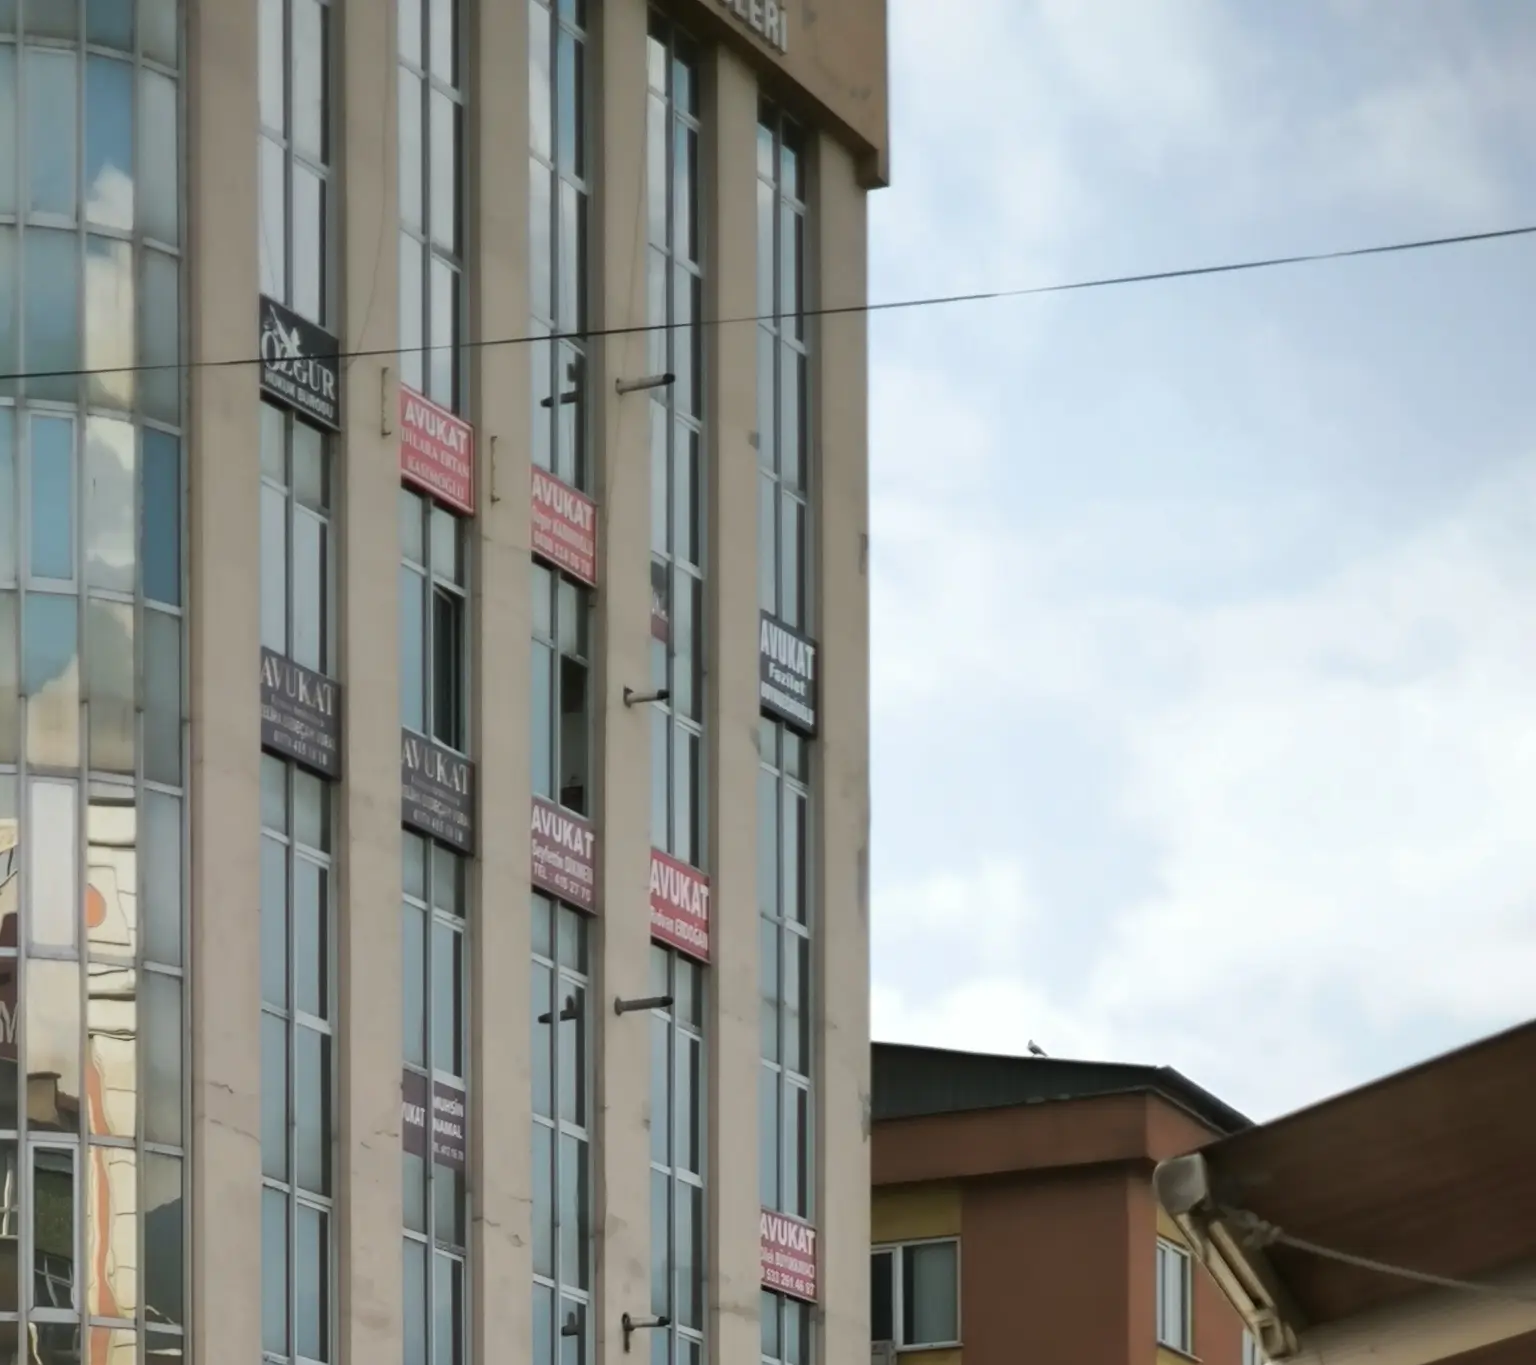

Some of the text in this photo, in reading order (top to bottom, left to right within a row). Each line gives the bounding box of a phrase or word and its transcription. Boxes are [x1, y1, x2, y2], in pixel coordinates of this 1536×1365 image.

[405, 399, 467, 455] AVUKAT
[533, 475, 593, 527] AVUKAT
[761, 619, 815, 681] AVUKAT
[261, 655, 334, 716] AVUKAT
[403, 738, 469, 796] AVUKAT
[532, 804, 595, 860] AVUKAT
[651, 859, 709, 920] AVUKAT
[761, 1212, 816, 1256] AVUKAT
